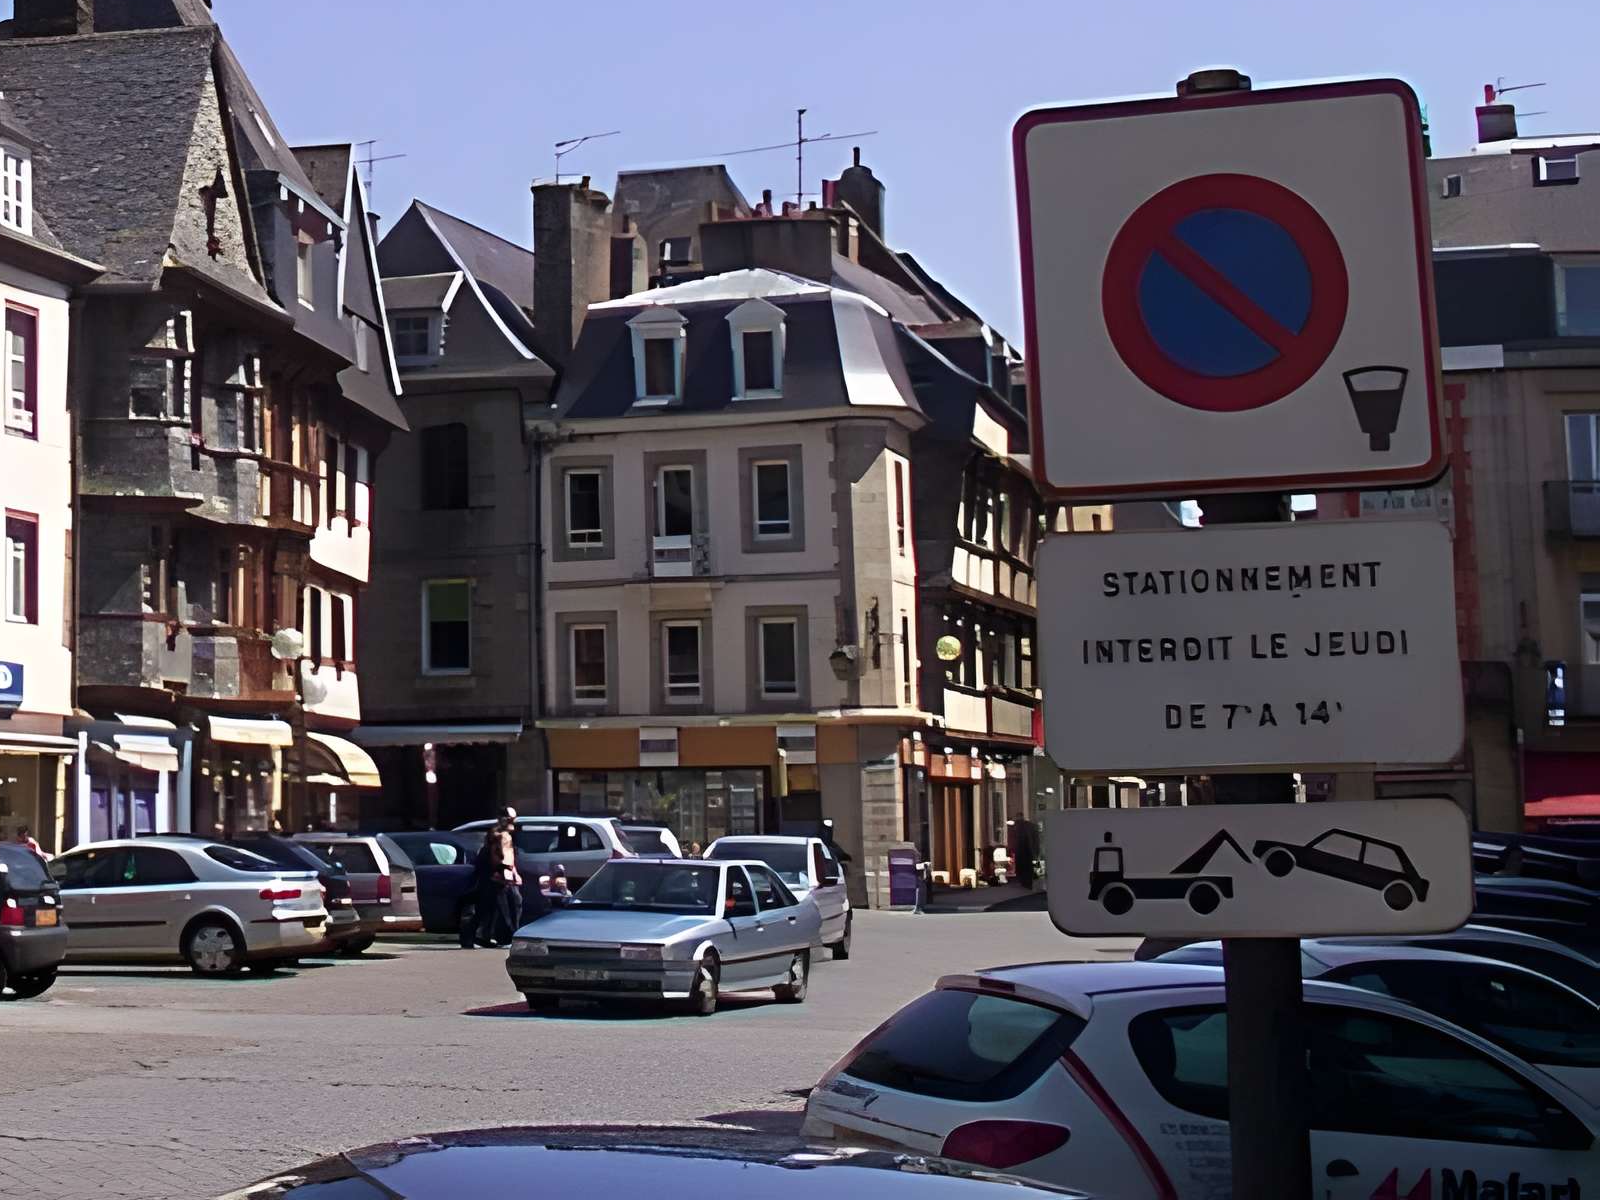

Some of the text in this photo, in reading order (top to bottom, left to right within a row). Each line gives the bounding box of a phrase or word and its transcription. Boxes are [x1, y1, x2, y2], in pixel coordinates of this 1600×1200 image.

[1103, 561, 1381, 598] STATIONNEMENT
[1083, 630, 1408, 664] INTERDIT LE JEUDI
[1165, 704, 1206, 729] DE
